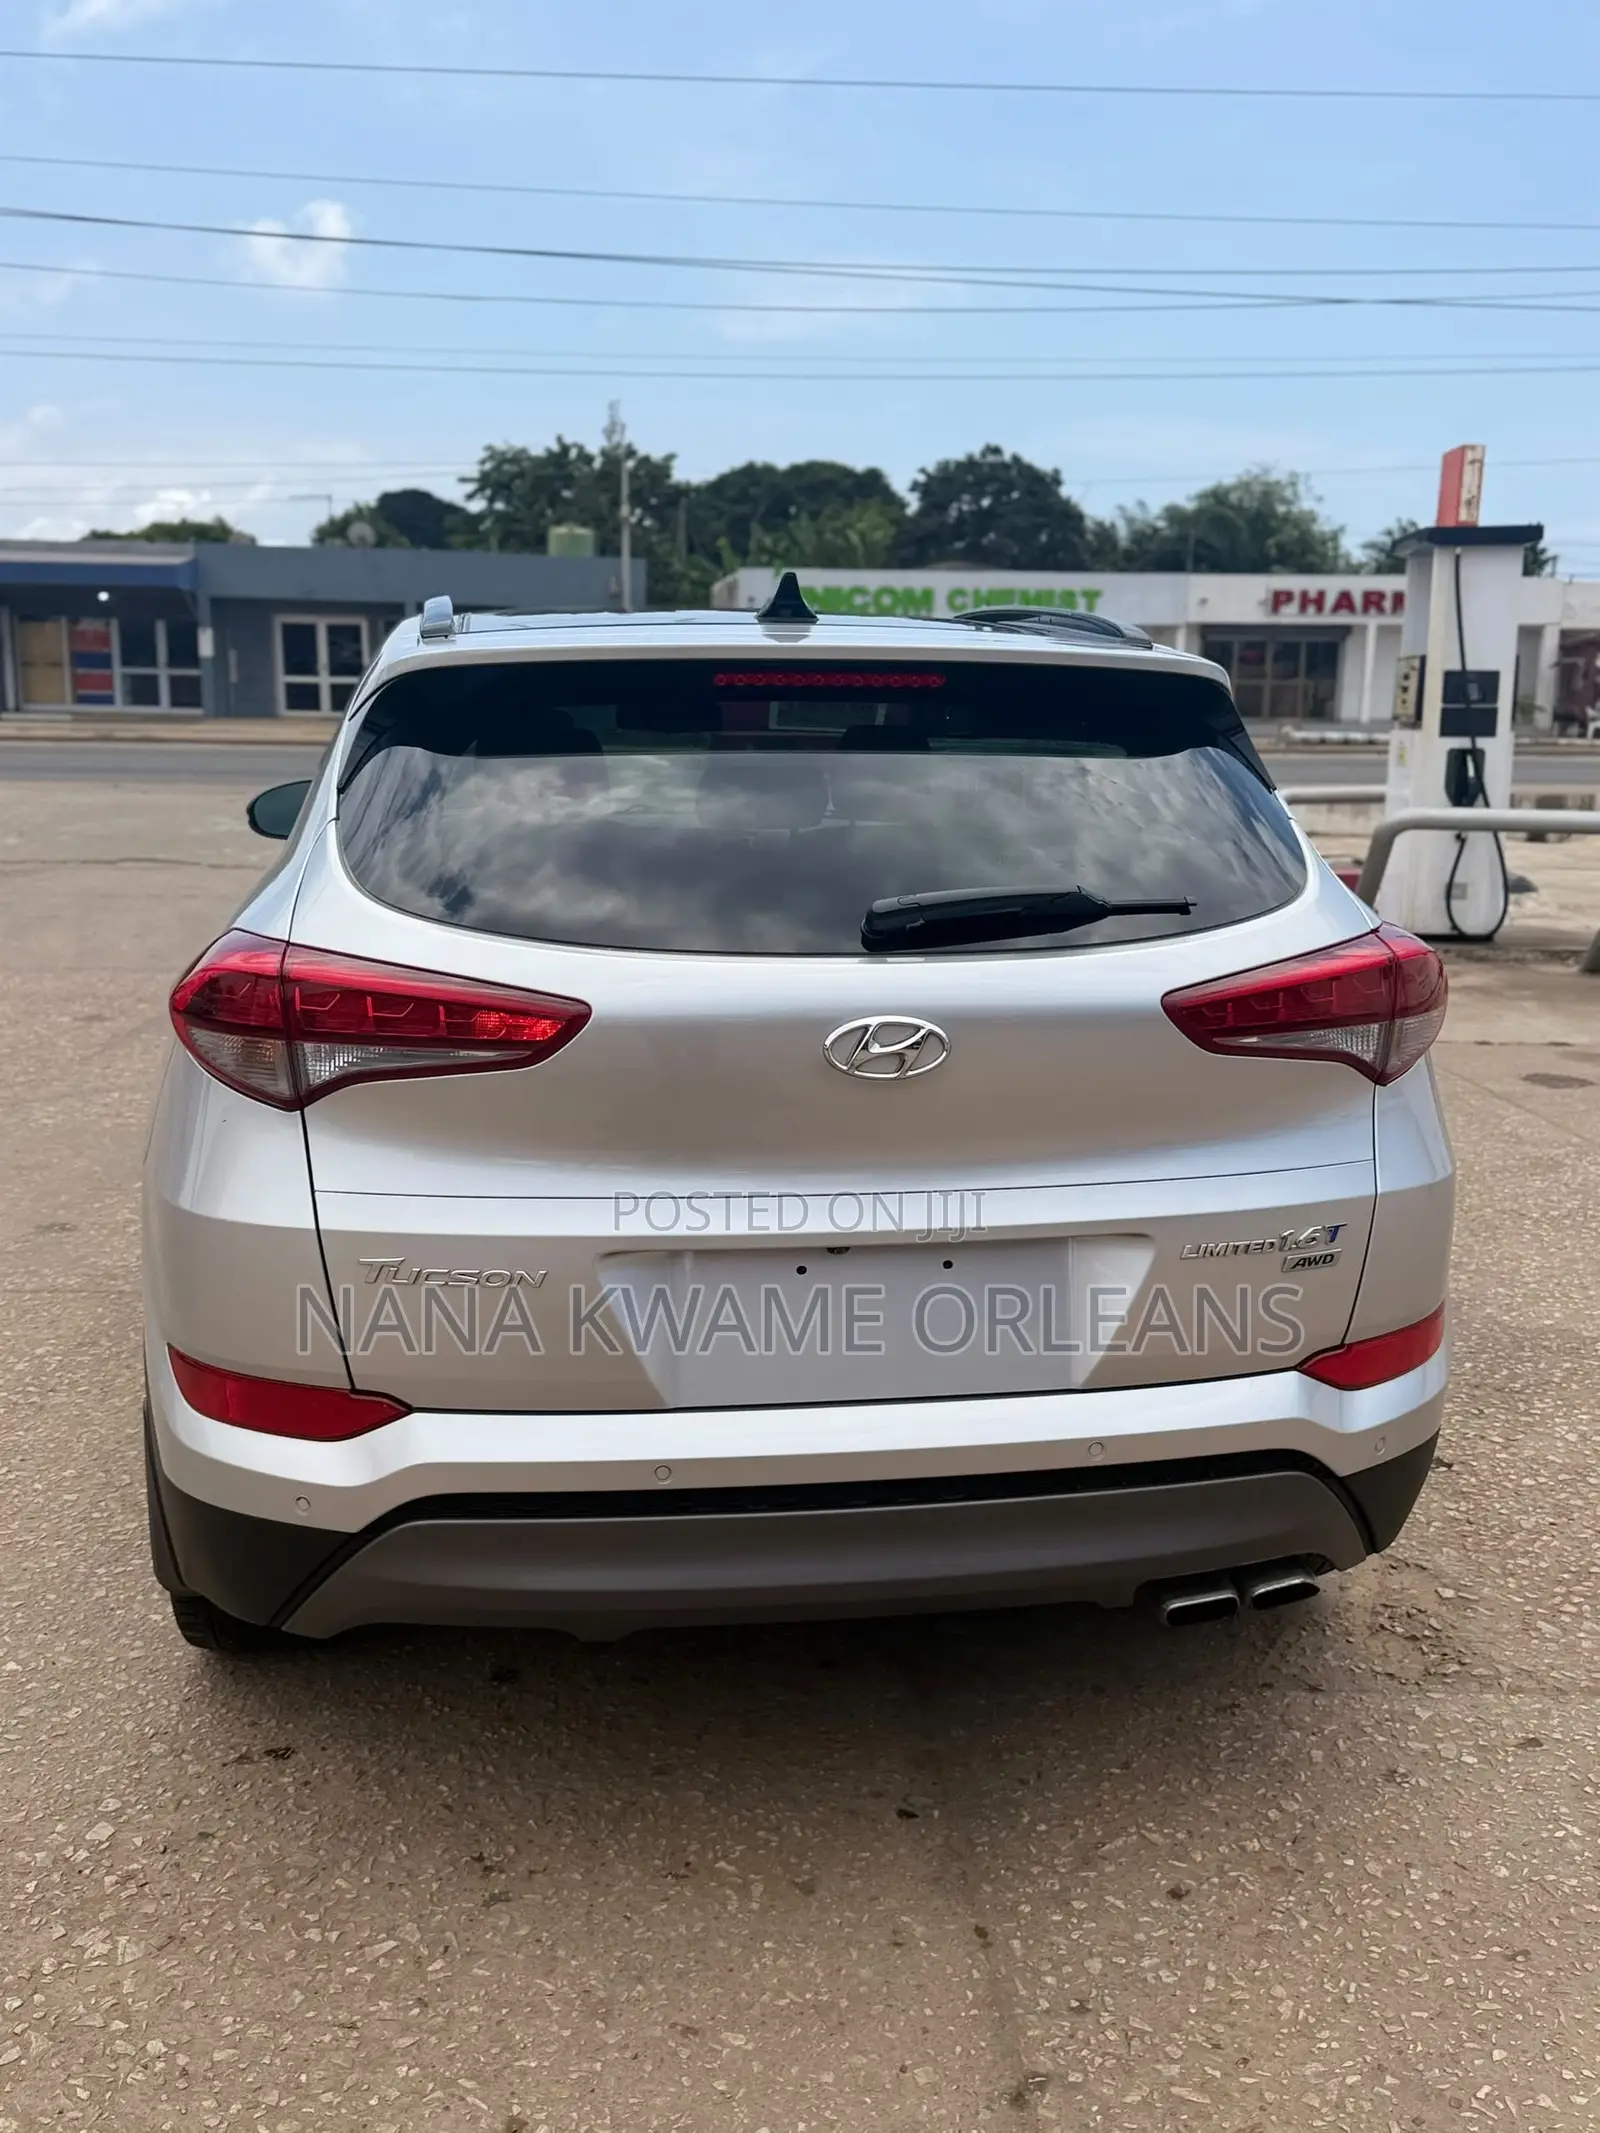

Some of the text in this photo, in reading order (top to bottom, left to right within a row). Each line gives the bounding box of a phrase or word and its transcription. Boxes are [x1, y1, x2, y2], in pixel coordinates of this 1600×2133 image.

[947, 587, 1104, 612] CHEMIST
[1179, 1239, 1278, 1260] LIMITED
[358, 1256, 549, 1288] TUCSON
[1291, 1253, 1335, 1270] AWD
